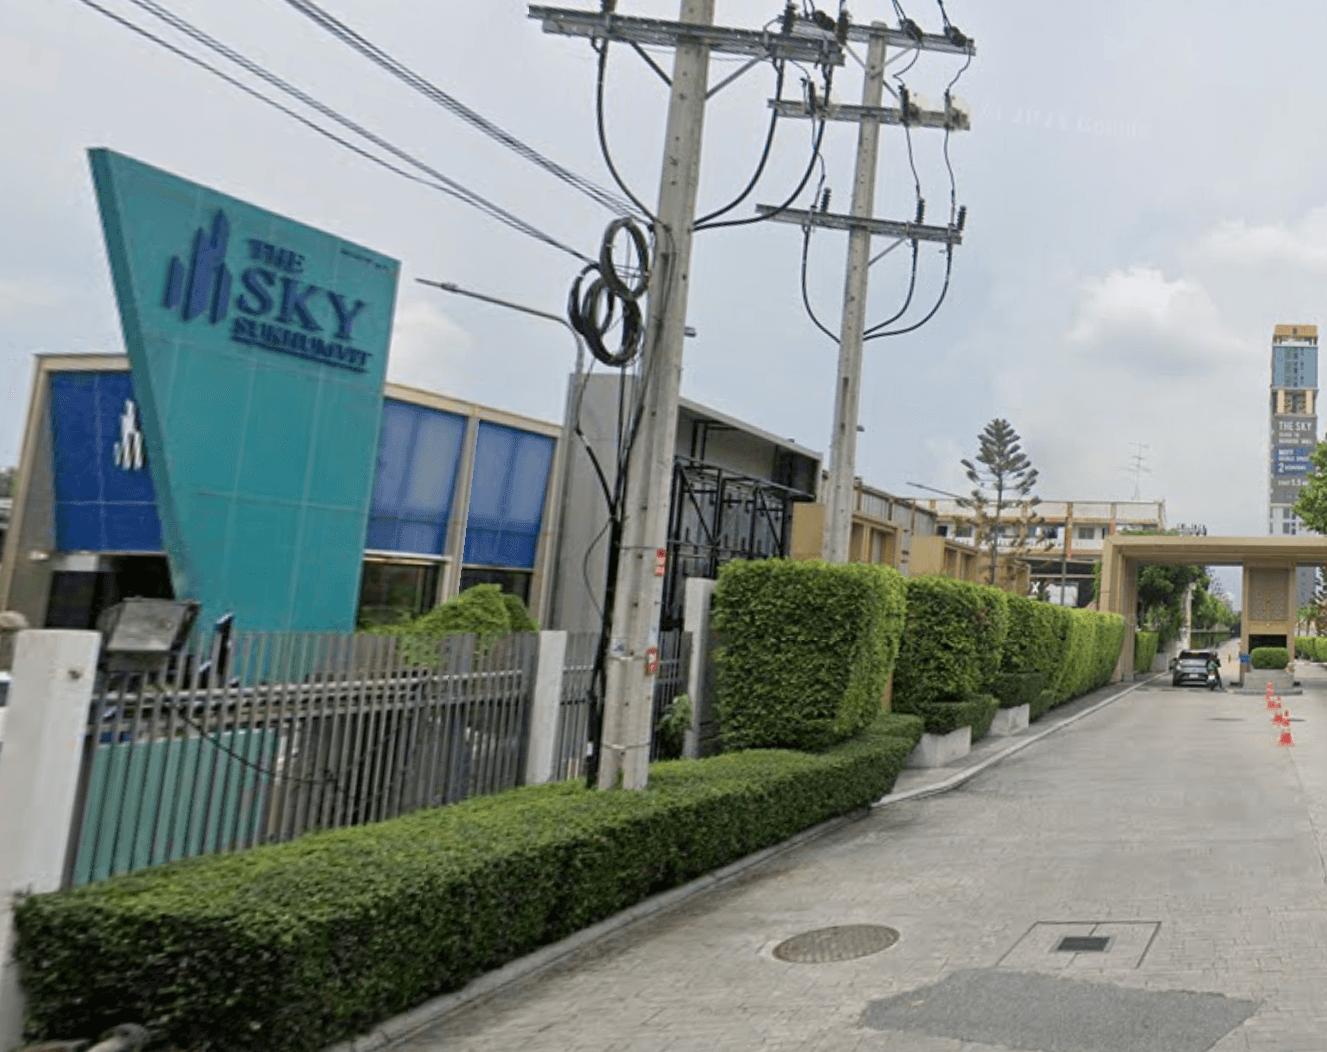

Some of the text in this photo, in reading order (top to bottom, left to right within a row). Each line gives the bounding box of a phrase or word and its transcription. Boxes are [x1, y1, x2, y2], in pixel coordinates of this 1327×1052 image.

[246, 238, 306, 274] THE
[235, 265, 368, 341] SKY
[231, 316, 374, 367] SUKHUMVIT
[1278, 421, 1312, 431] THE SKY
